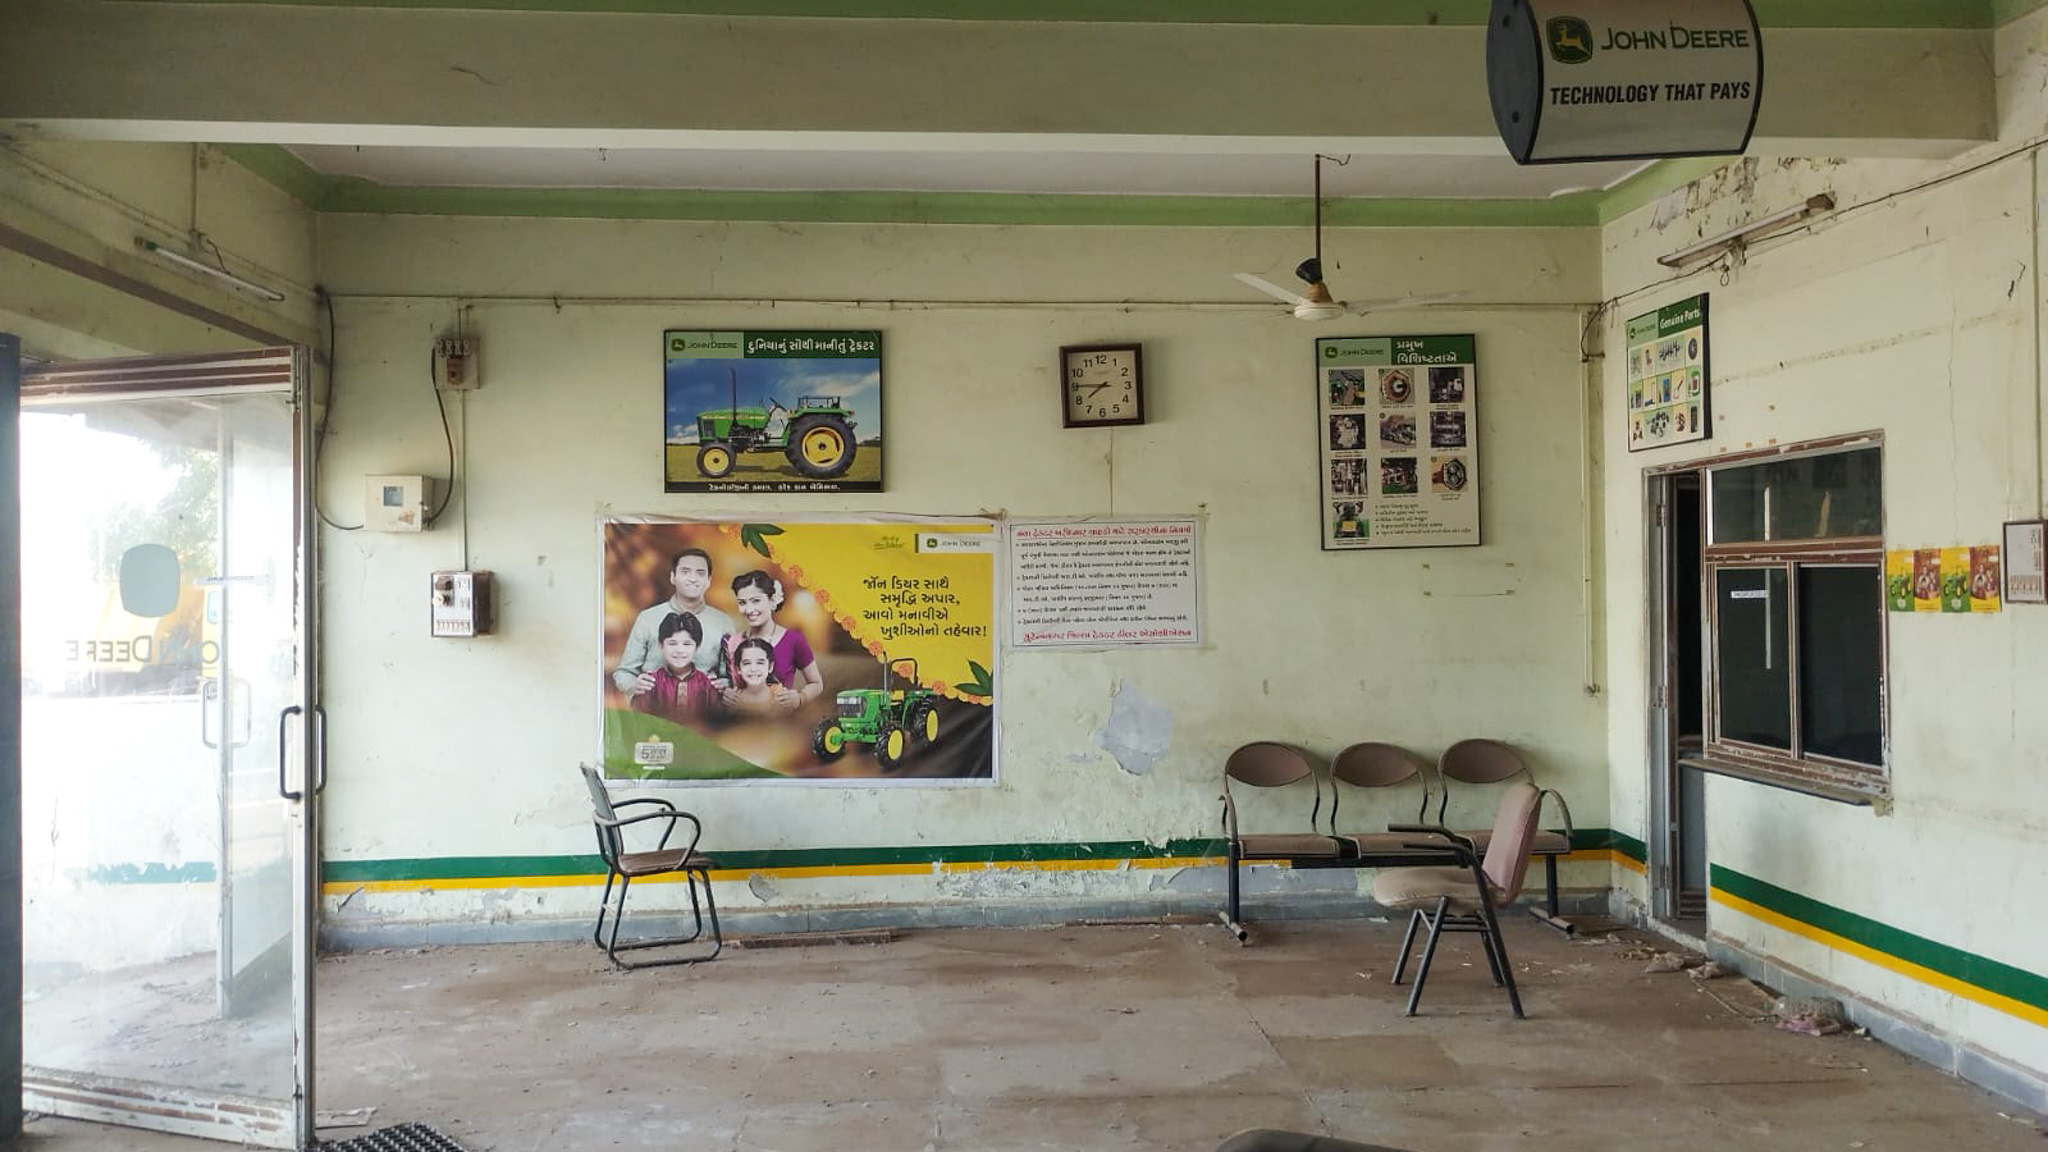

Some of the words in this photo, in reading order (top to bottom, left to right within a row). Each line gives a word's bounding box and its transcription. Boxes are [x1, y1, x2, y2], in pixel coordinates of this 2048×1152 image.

[1601, 27, 1667, 50] JOHN
[1670, 23, 1749, 49] DEERE
[1550, 84, 1660, 105] TECHNOLOGY
[1665, 83, 1705, 101] THAT
[1710, 81, 1751, 99] PAYS
[1084, 359, 1093, 368] 11
[1095, 355, 1107, 364] 12
[1072, 368, 1084, 378] 10
[1121, 367, 1129, 377] 2
[1072, 382, 1079, 391] 9
[1124, 381, 1132, 390] 3
[1076, 395, 1083, 405] 8
[1122, 394, 1129, 403] 4
[1085, 405, 1092, 414] 7
[1099, 407, 1106, 417] 6
[1112, 404, 1120, 413] 5
[892, 575, 920, 589] ડિયર
[924, 576, 949, 589] સાથે
[921, 593, 960, 605] અપાર,
[863, 607, 893, 620] આવો
[898, 607, 948, 620] મનાવીએ
[880, 623, 939, 640] ખુશીઓનો
